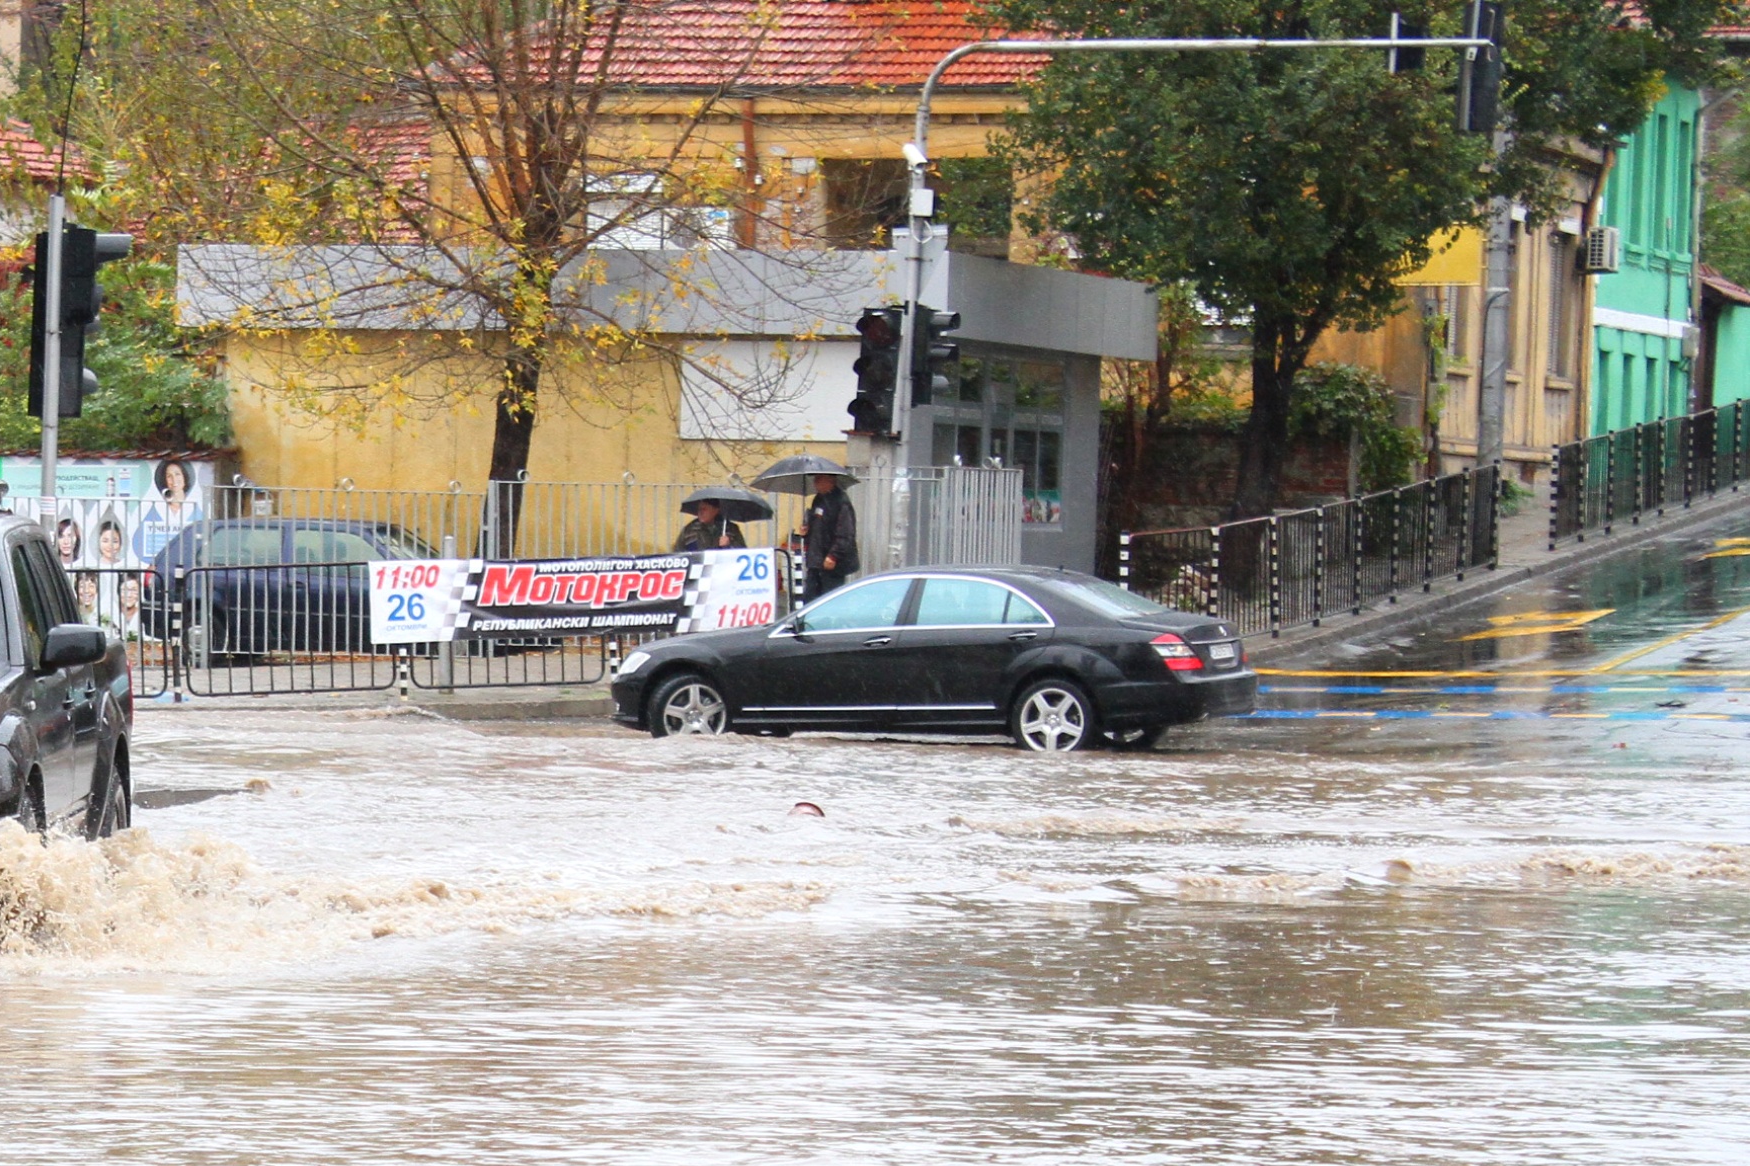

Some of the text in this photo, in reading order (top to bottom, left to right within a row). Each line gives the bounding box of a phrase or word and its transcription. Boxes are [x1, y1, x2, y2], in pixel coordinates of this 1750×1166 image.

[376, 564, 440, 589] 11:00
[539, 557, 689, 573] МОТОПОЛИГОН ХАСКОВО
[736, 554, 769, 581] 26
[387, 593, 425, 621] 26
[717, 602, 772, 627] 11:00
[472, 613, 677, 632] РЕПУБЛИКАНСКИ ШАМПИОНАТ
